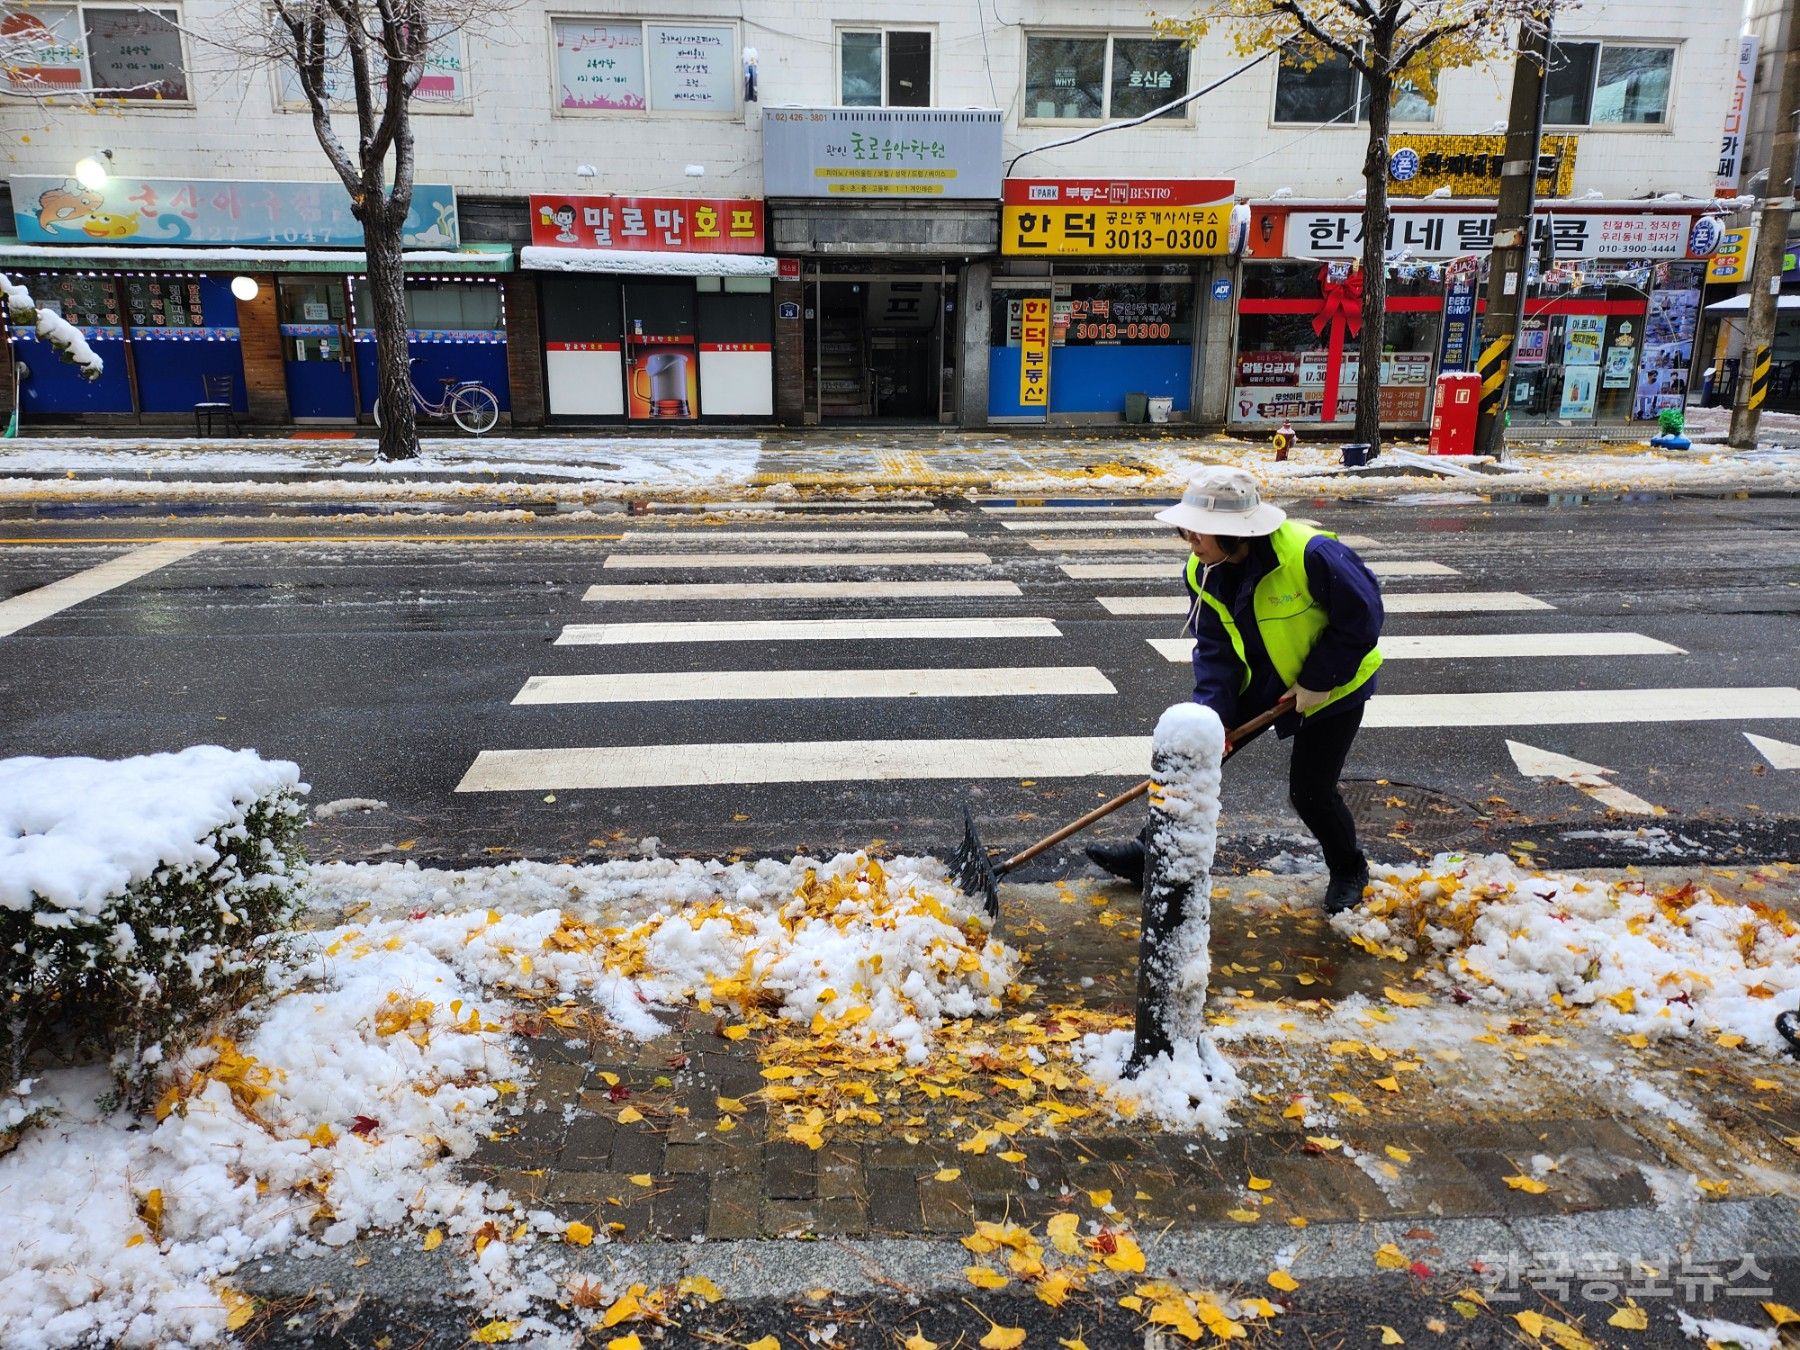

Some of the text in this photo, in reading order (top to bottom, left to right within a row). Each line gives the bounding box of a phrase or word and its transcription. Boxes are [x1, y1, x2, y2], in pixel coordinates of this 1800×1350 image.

[1055, 78, 1076, 87] WHYS
[1128, 68, 1173, 88] 호신술
[775, 114, 788, 122] 02)
[789, 114, 804, 122] 426
[810, 114, 828, 122] 3801
[826, 131, 945, 161] 관인 초로음악학원
[1066, 187, 1109, 200] 부동산
[1112, 187, 1127, 200] 114
[584, 205, 756, 247] 말로만 호프
[1018, 212, 1218, 248] 한덕 공인중개사사무소
[1602, 220, 1681, 230] 친절하고, 정직한
[1105, 229, 1218, 249] 3013-0300
[1601, 232, 1680, 241] 우리동네 최저가
[1599, 245, 1677, 253] 010-3900-4444
[1215, 285, 1230, 295] ADT
[1449, 296, 1472, 306] BEST
[1071, 300, 1110, 319] 한덕
[1447, 306, 1471, 315] SHOP
[1076, 323, 1171, 339] 3013-0300
[1242, 362, 1295, 374] 알뜰요금제
[1392, 363, 1427, 383] 무료
[1275, 392, 1302, 400] 무엇이든
[1264, 403, 1311, 418] 우리동네
